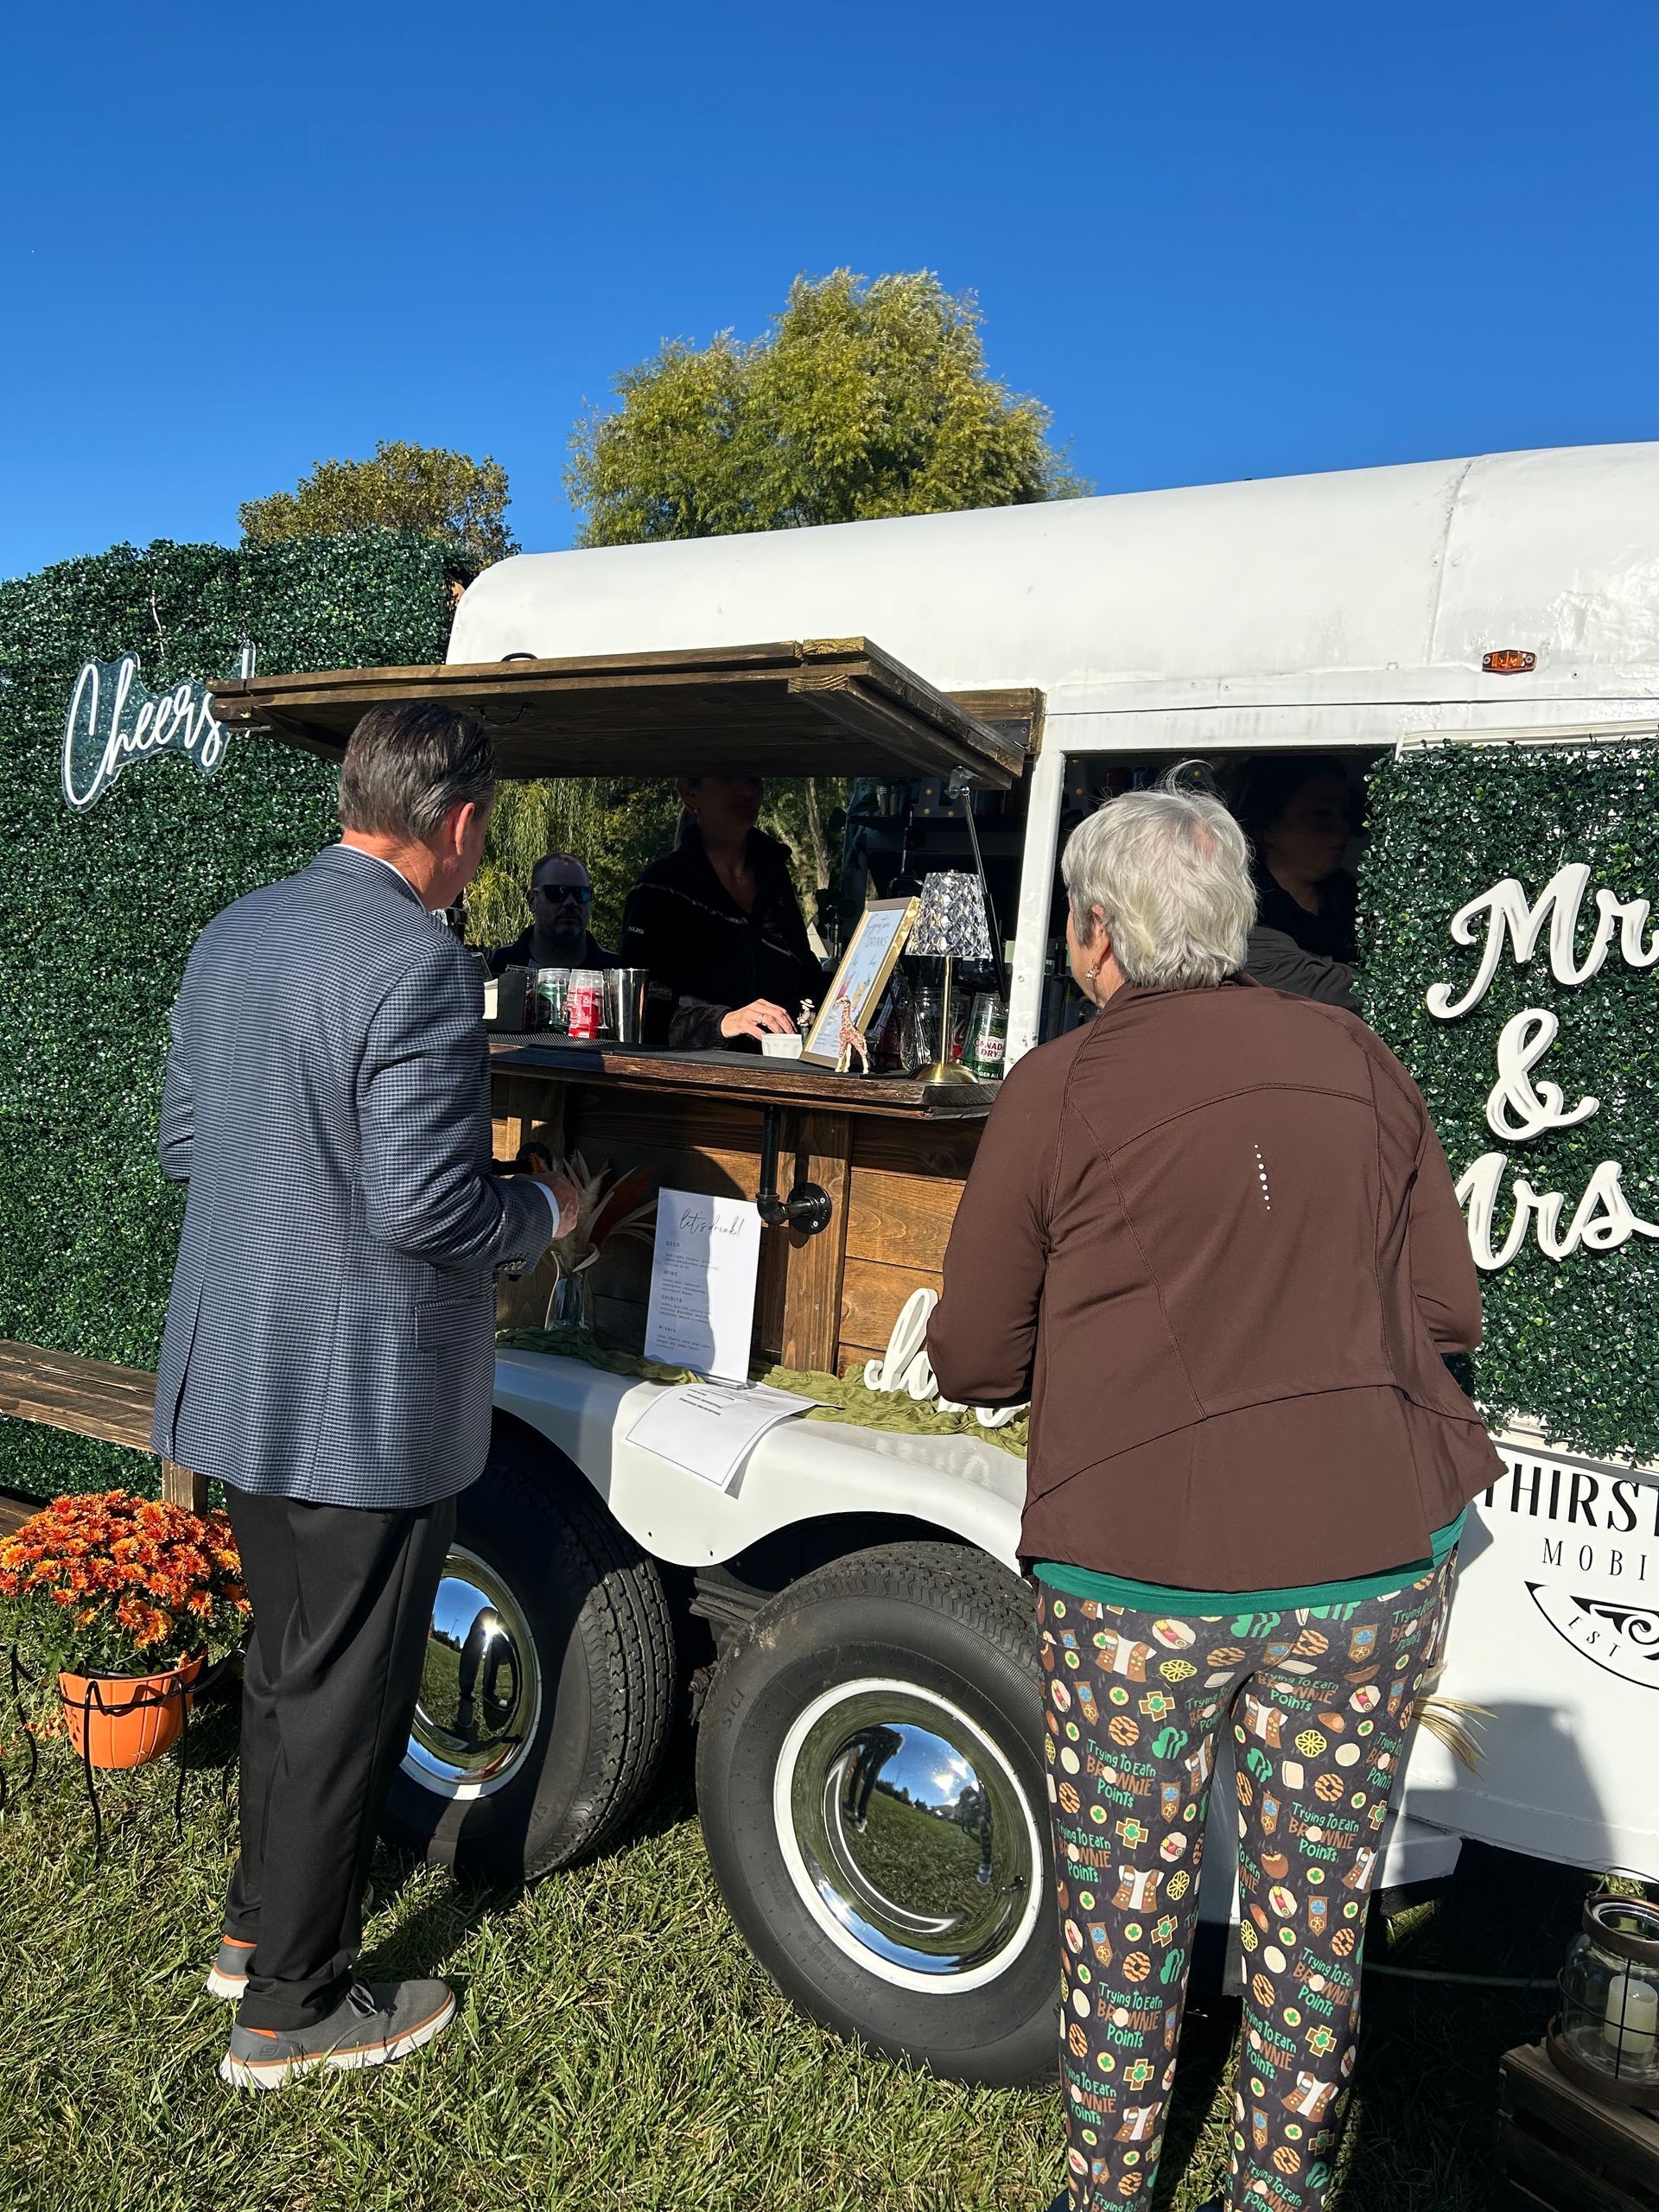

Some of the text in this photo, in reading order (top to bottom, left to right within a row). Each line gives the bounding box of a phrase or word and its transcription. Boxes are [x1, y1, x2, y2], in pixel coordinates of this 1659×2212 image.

[981, 1048, 999, 1058] DRY
[1486, 1007, 1599, 1141] &
[1567, 1616, 1621, 1657] EST
[1270, 1689, 1313, 1712] Points
[1313, 1681, 1339, 1690] Earn
[1088, 1738, 1156, 1777] Trying To Earn
[1097, 1778, 1135, 1808] Points
[1293, 1802, 1359, 1833] Trying To Earn
[1056, 1818, 1111, 1849] Trying To Earn
[1299, 1838, 1338, 1862] Points
[1066, 1859, 1098, 1883] Points
[1302, 1947, 1332, 1976] Trying
[1331, 1963, 1342, 1982] To
[1099, 1981, 1163, 2011] Trying To Earn
[1298, 1984, 1334, 2017] Points
[1107, 2023, 1144, 2048] Points
[1242, 1997, 1297, 2053] Trying To Earn
[1247, 2040, 1276, 2079] Points
[1092, 2081, 1116, 2097] Earn
[1070, 2097, 1102, 2126] Points
[1248, 2156, 1274, 2184] Trying
[1272, 2177, 1283, 2193] To
[1281, 2188, 1302, 2206] Earn
